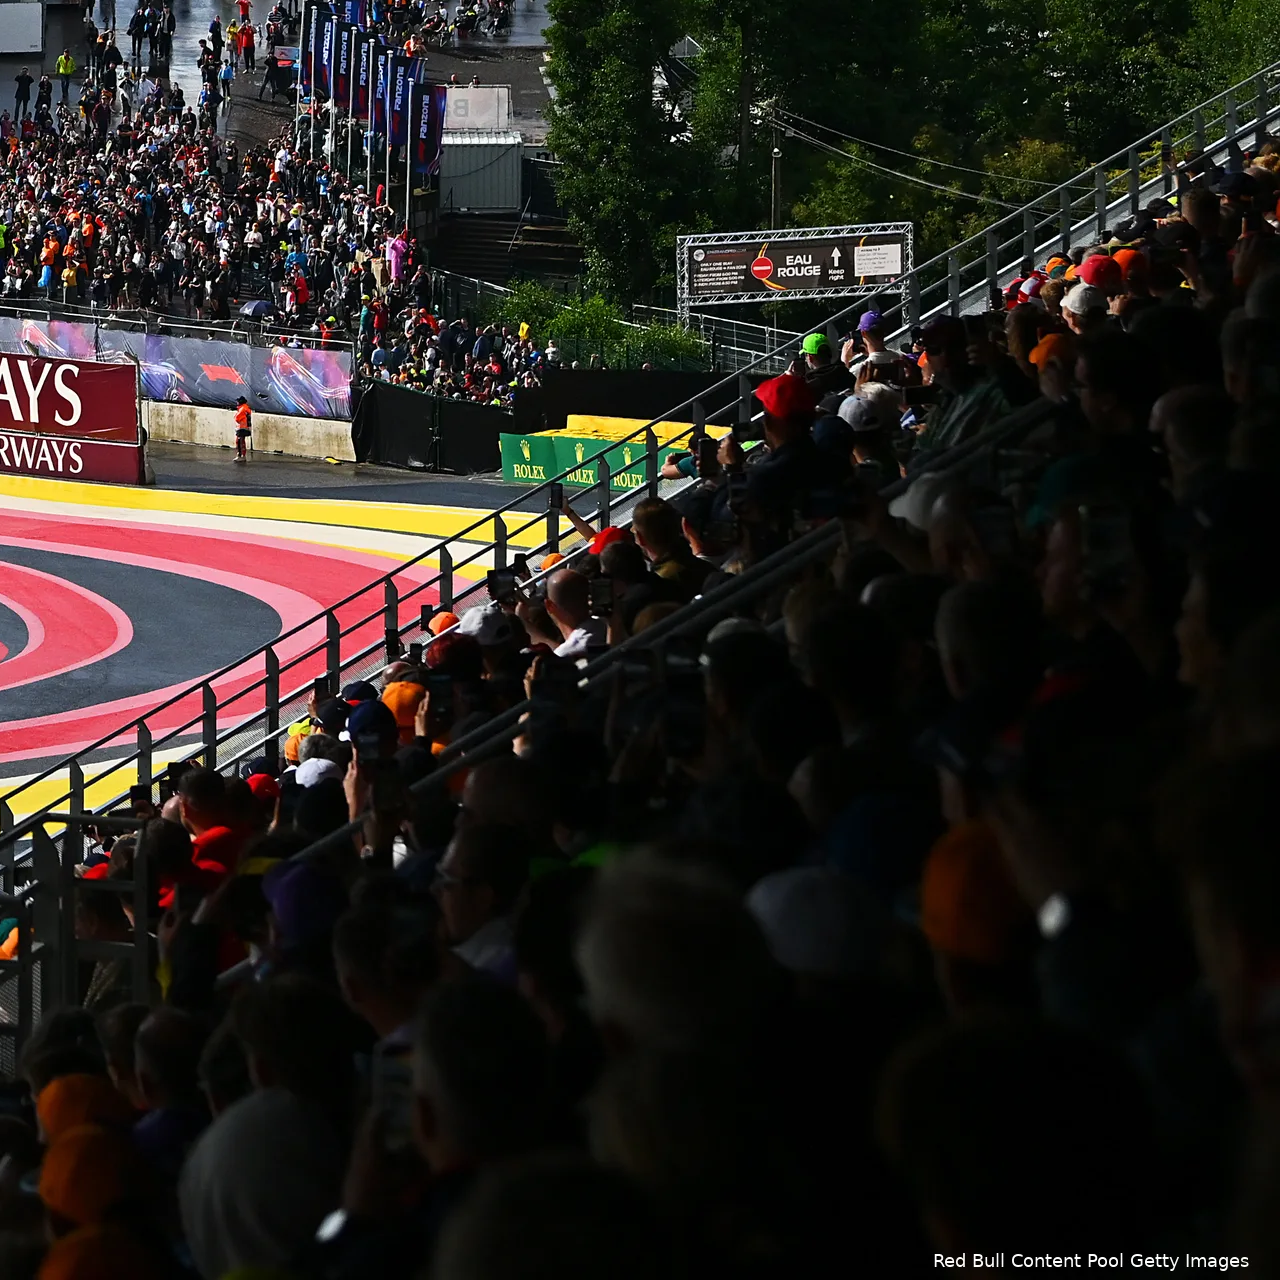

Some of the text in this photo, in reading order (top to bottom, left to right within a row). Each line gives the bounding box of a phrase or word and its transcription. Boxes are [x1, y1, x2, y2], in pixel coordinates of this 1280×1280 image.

[340, 31, 348, 74] Fanzone
[359, 42, 368, 86] Fanzone
[394, 66, 405, 111] Fanzone
[420, 95, 430, 139] Fanzone
[786, 254, 812, 266] EAU
[777, 265, 821, 278] ROUGE
[828, 268, 845, 276] Keep
[829, 273, 844, 281] right
[513, 464, 547, 480] ROLEX
[566, 468, 595, 485] ROLEX
